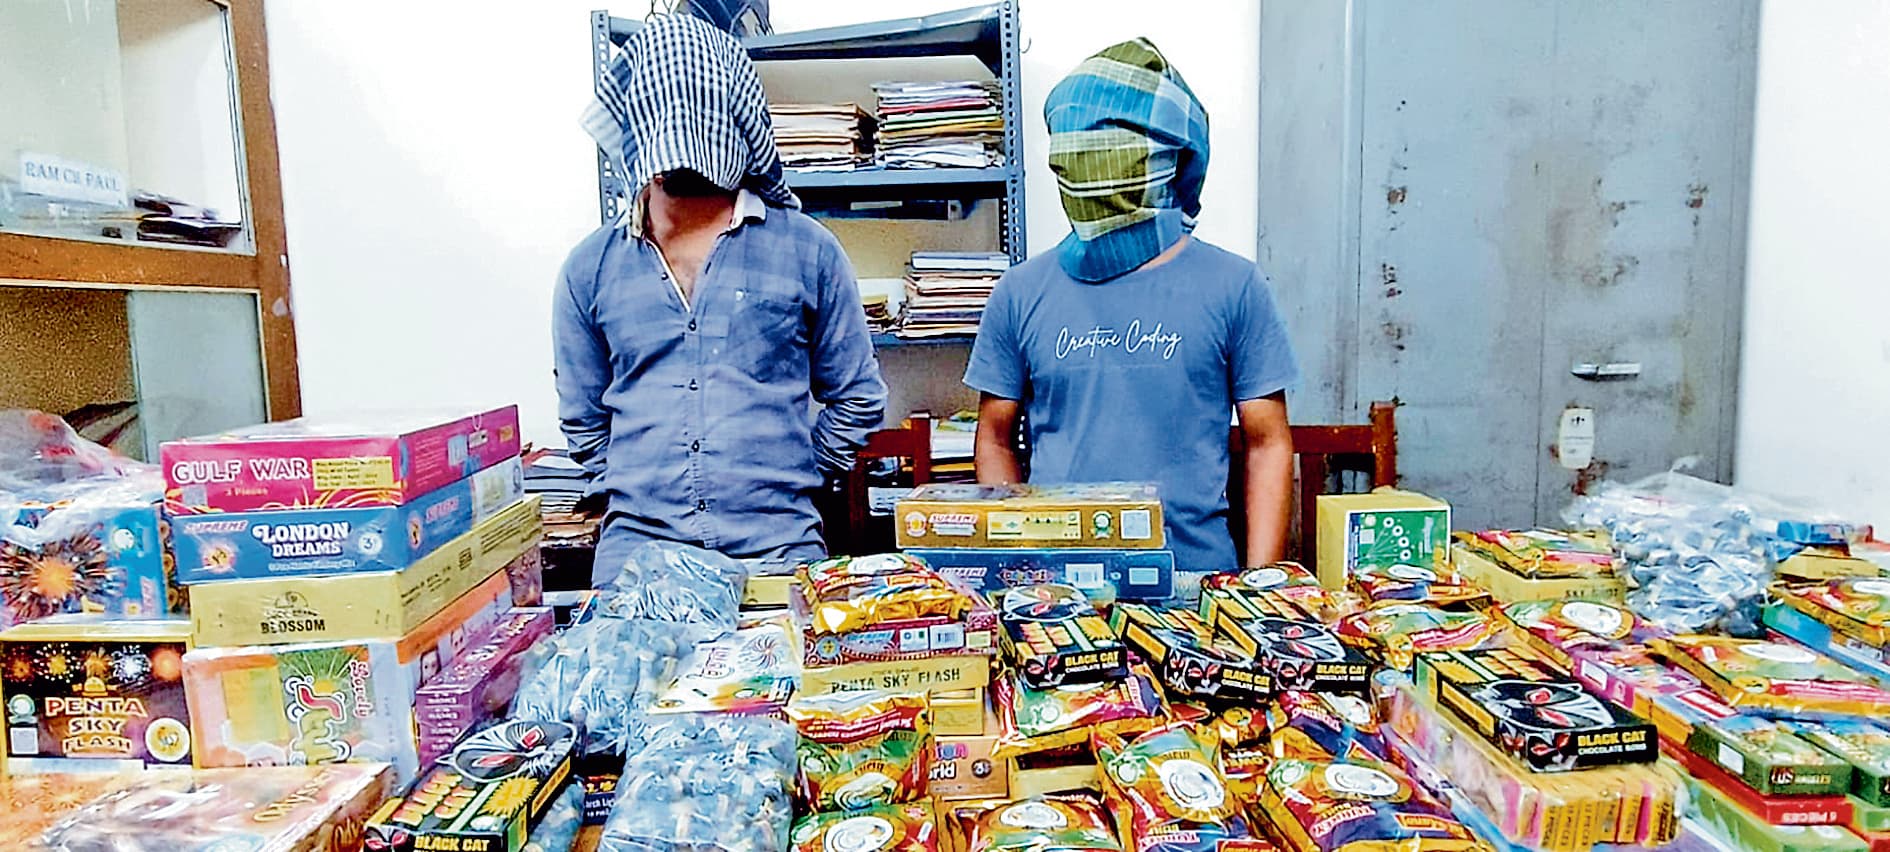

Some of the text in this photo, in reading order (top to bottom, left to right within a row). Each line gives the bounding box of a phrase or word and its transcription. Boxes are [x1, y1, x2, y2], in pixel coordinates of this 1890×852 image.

[1055, 319, 1182, 360] Creative Coding
[172, 460, 242, 484] GULF
[249, 457, 311, 481] WAR
[251, 521, 350, 544] LONDON
[271, 540, 342, 558] DREAMS
[1064, 651, 1120, 668] BLACK CAT
[883, 673, 910, 689] SKY
[918, 667, 961, 684] FLASH
[1222, 668, 1271, 687] BLACK CAT
[1316, 664, 1368, 676] BLACK CAT
[45, 697, 148, 717] PENTA
[67, 717, 125, 735] SKY
[62, 736, 133, 754] FLASH
[1577, 730, 1647, 747] BLACK CAT
[928, 760, 957, 780] rld
[414, 835, 491, 852] BLACK CAT
